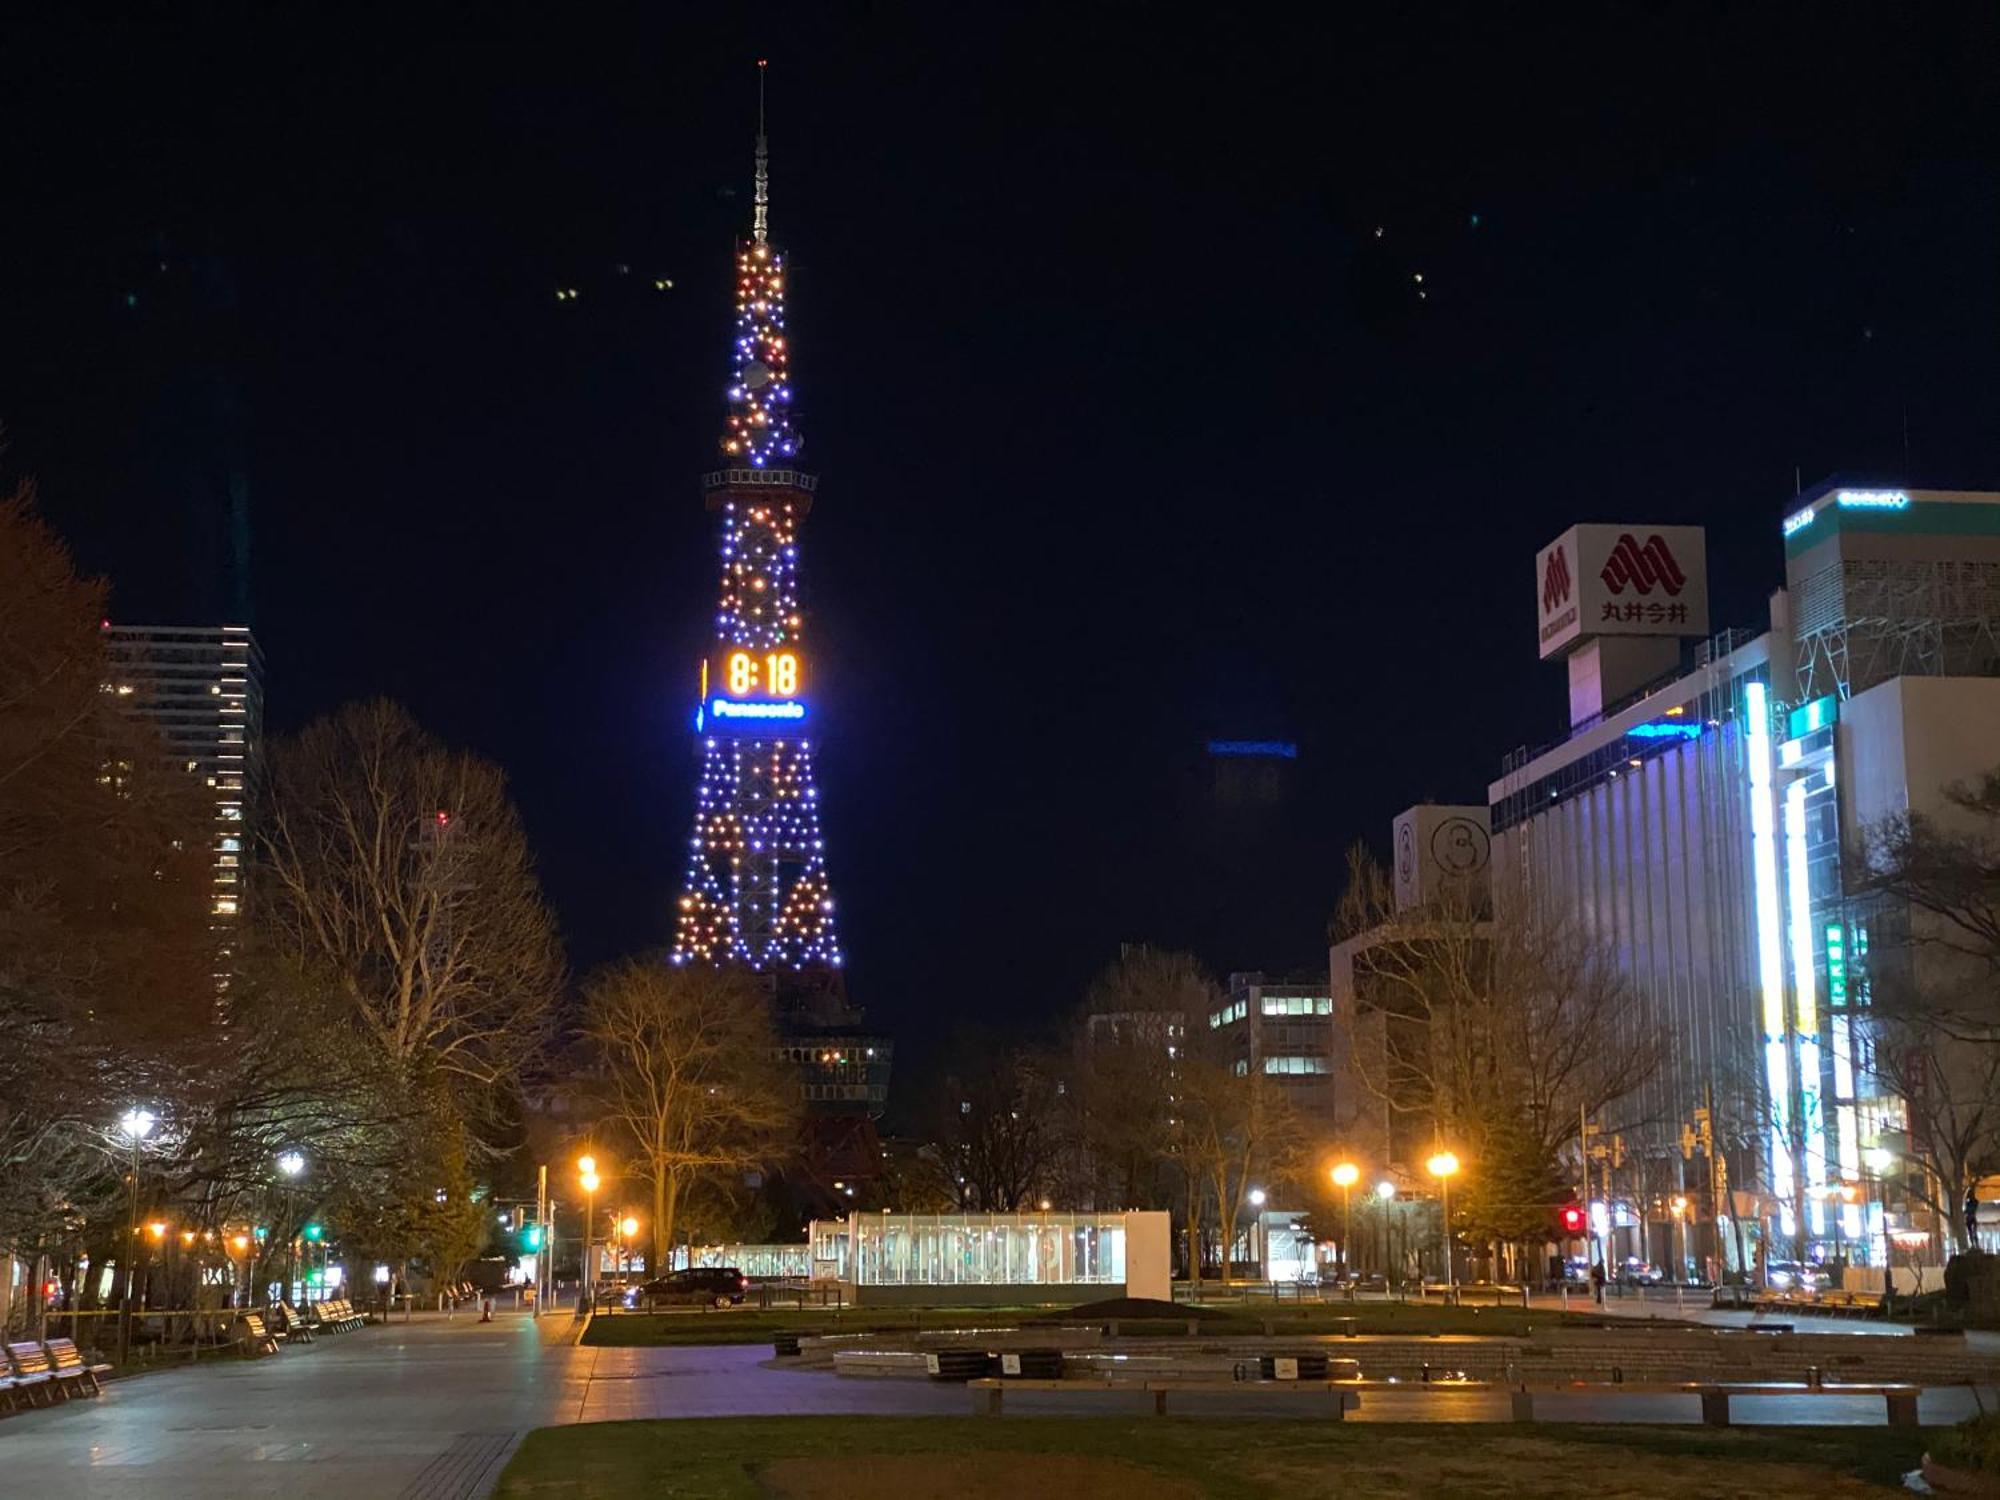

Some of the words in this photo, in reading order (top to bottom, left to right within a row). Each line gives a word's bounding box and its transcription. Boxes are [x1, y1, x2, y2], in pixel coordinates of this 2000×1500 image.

[1601, 602, 1688, 624] 丸井今井
[730, 653, 797, 695] 8:18
